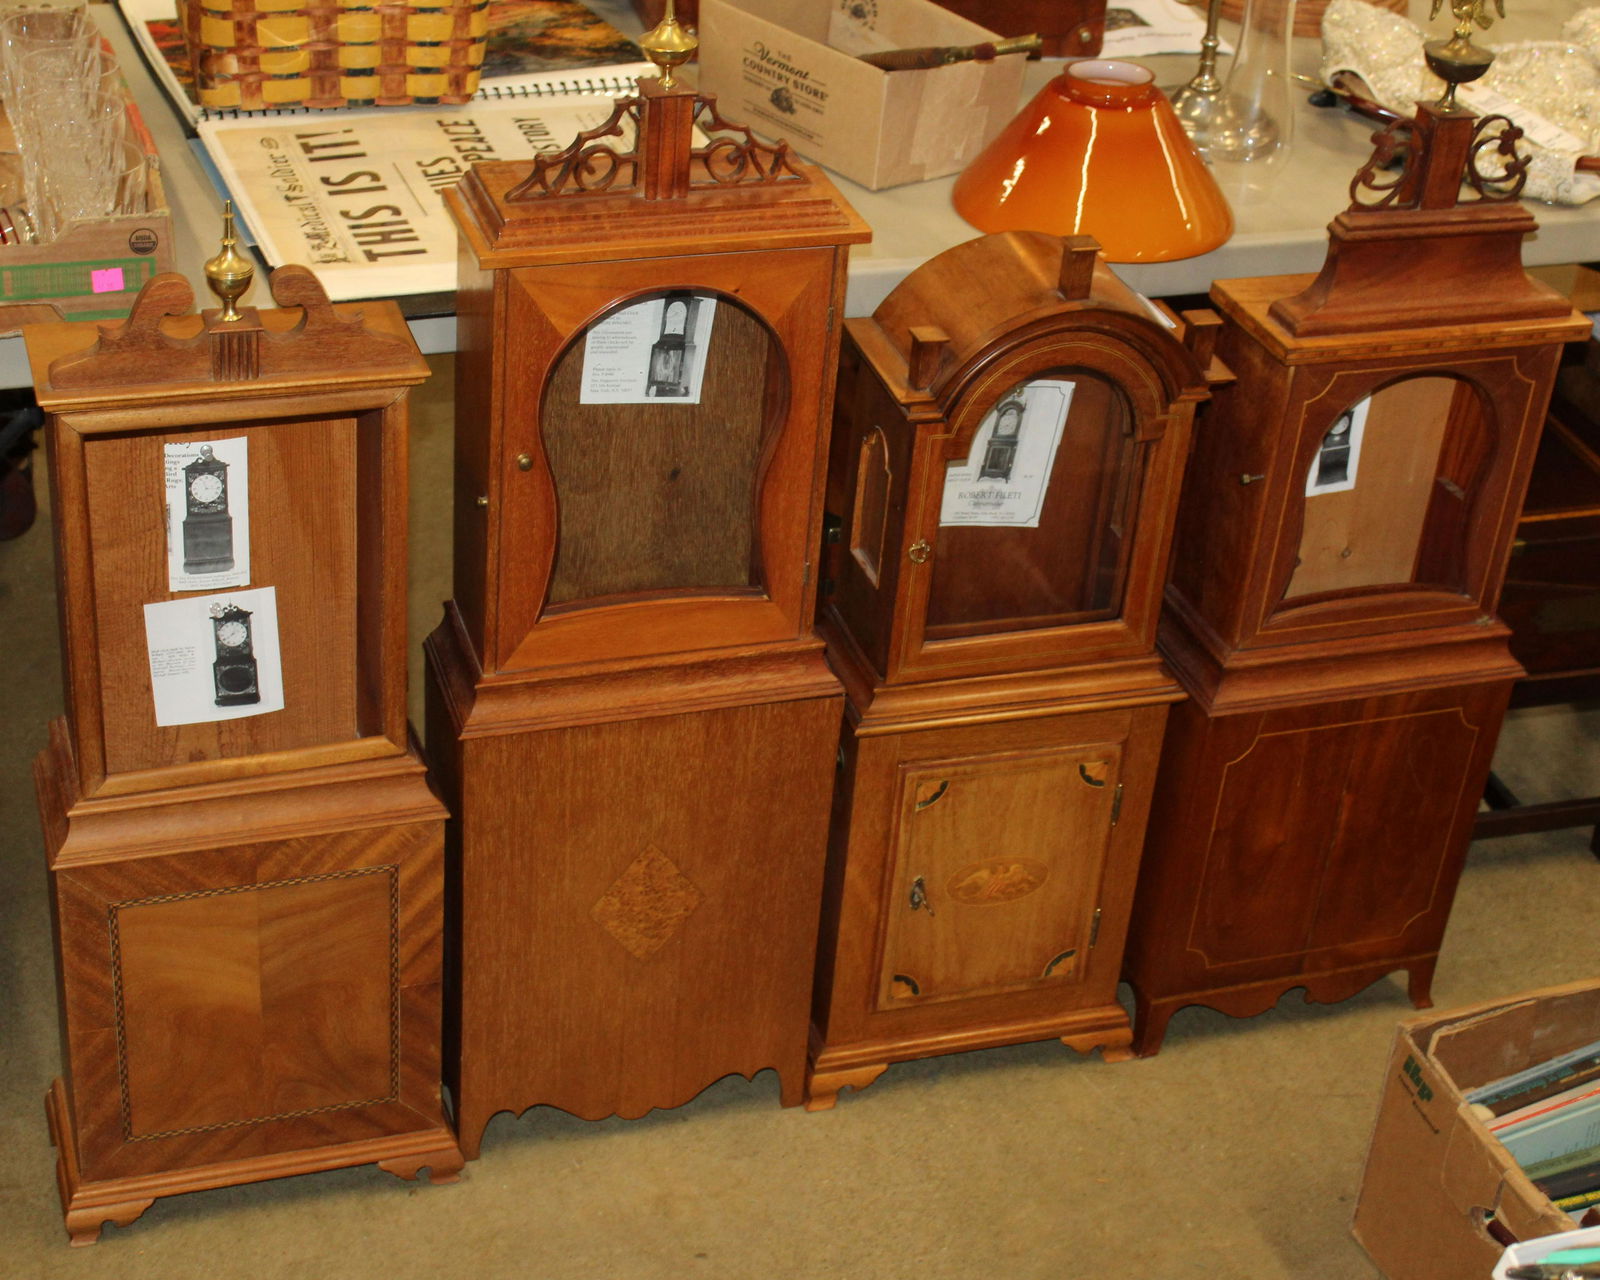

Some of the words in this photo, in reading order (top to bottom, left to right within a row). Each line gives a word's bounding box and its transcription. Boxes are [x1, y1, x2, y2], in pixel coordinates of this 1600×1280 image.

[743, 57, 790, 84] COUNTRY
[754, 41, 810, 79] Vermont
[295, 128, 367, 163] IT!
[436, 120, 502, 162] PEACE
[267, 153, 304, 194] Soldier
[320, 170, 388, 196] IS
[339, 204, 428, 262] THIS
